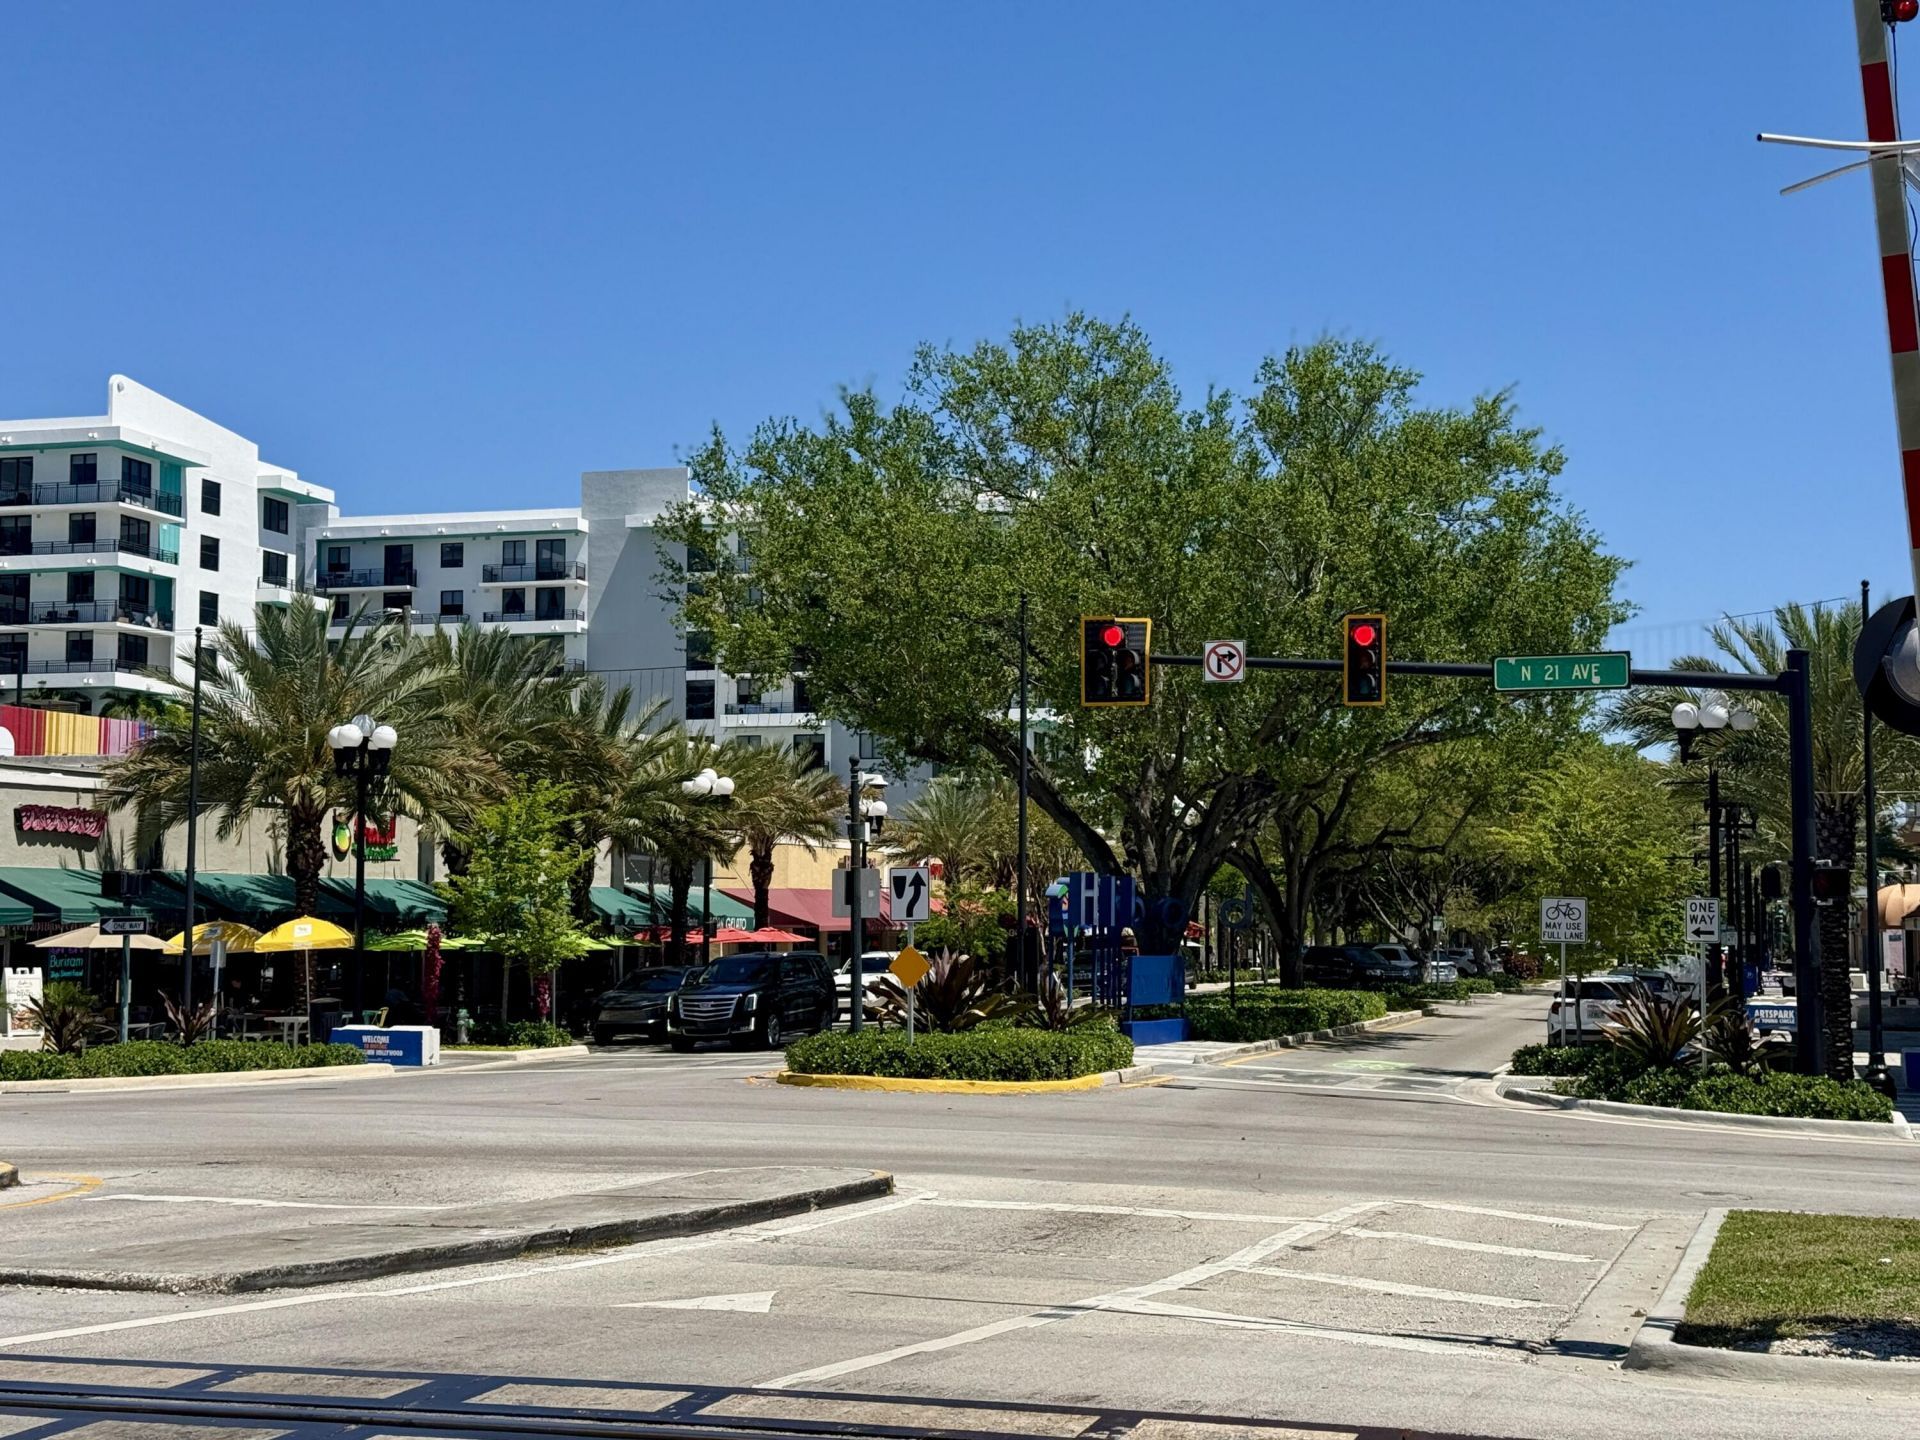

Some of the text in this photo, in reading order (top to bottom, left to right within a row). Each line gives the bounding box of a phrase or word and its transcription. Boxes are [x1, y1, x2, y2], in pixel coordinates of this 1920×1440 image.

[1521, 663, 1601, 681] N 21 AVE
[1690, 902, 1715, 912] ONE
[725, 917, 747, 930] GELATO
[1690, 914, 1715, 925] WAY
[113, 922, 142, 930] ONE WAY
[1545, 921, 1582, 930] MAY USE
[1543, 931, 1584, 940] FULL LANE
[1754, 1009, 1795, 1019] ARTSPARK
[362, 1035, 390, 1044] WELCOME
